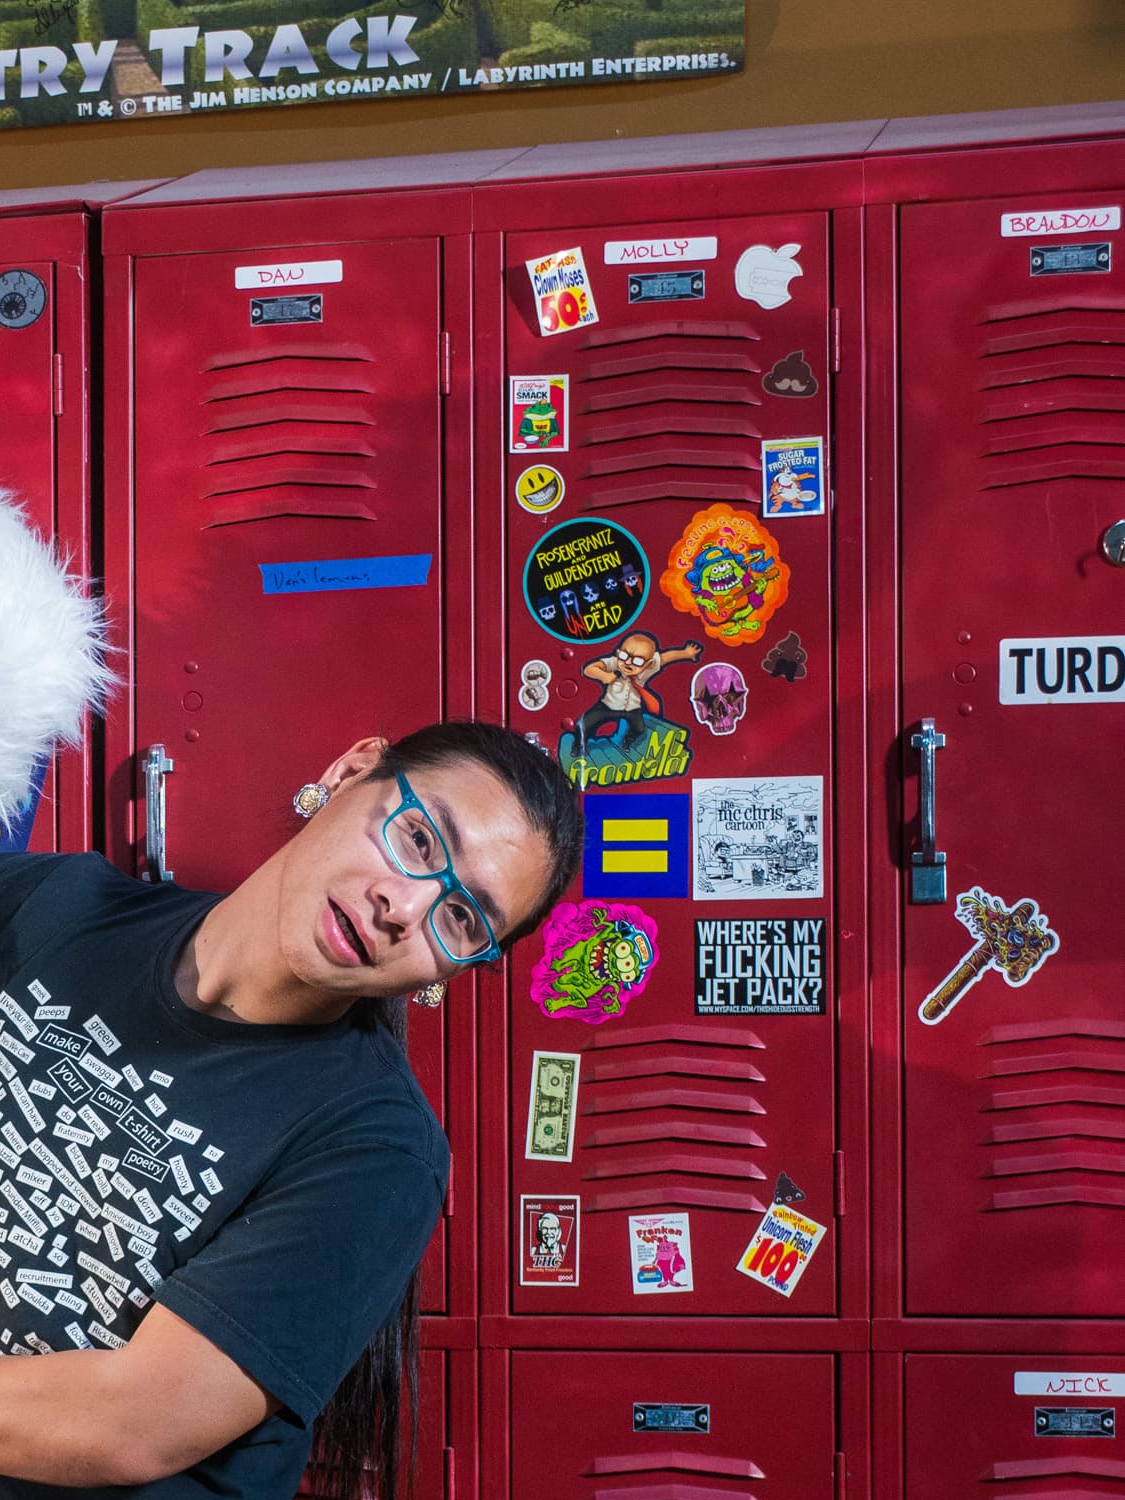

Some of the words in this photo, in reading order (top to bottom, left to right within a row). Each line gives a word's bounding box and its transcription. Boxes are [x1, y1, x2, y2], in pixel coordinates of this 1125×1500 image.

[149, 15, 418, 86] TRACK
[97, 101, 113, 117] &
[142, 95, 182, 112] THE
[189, 91, 227, 108] JIM
[233, 82, 317, 104] HENSON
[324, 73, 432, 96] COMPANY
[458, 61, 584, 85] LABYRINTH
[592, 53, 737, 76] ENTERPRISES.
[1009, 214, 1110, 232] BRANDON
[620, 240, 689, 260] MOLLY
[257, 268, 304, 283] DAN
[534, 274, 559, 296] Clown
[557, 268, 584, 288] Noses
[516, 391, 548, 399] SMACK
[768, 457, 802, 472] FROSTED
[803, 456, 817, 465] FAT
[778, 450, 804, 460] SUGAR
[535, 528, 615, 569] ROSENCRANTZ
[572, 555, 586, 564] AND
[544, 550, 623, 591] GUILDENSTERN
[590, 601, 607, 612] ARE
[718, 809, 742, 822] mc
[744, 803, 784, 821] chris
[720, 800, 734, 810] the
[725, 820, 765, 831] cartoon
[697, 920, 786, 945] WHERE'S
[793, 920, 824, 944] MY
[699, 945, 821, 978] FUCKING
[697, 978, 740, 1005] JET
[747, 978, 824, 1005] PACK?
[39, 1008, 66, 1017] peeps
[44, 1031, 81, 1054] make
[90, 1020, 115, 1048] green
[54, 1065, 84, 1092] your
[84, 1057, 116, 1083] swagga
[98, 1091, 124, 1111] own
[28, 1107, 43, 1127] have
[61, 1110, 72, 1120] do
[5, 1127, 23, 1151] where
[57, 1125, 91, 1144] fraternity
[125, 1115, 162, 1150] t-shirt
[173, 1126, 196, 1141] rush
[33, 1142, 63, 1174] chopped
[127, 1153, 165, 1176] poetry
[21, 1170, 47, 1185] mixer
[4, 1185, 24, 1212] Dunder
[60, 1198, 75, 1211] IDK
[137, 1194, 157, 1221] dorm
[559, 1204, 574, 1212] good
[104, 1207, 136, 1232] American
[136, 1225, 153, 1240] boy
[169, 1201, 196, 1226] sweet
[13, 1232, 39, 1252] atcha
[635, 1226, 683, 1239] Franken
[761, 1215, 792, 1244] Unicorn
[789, 1230, 814, 1256] Flesh
[132, 1241, 152, 1257] NBD
[80, 1258, 99, 1272] more
[532, 1256, 562, 1268] THC
[19, 1271, 68, 1286] recruitment
[21, 1287, 50, 1311] woulda
[60, 1293, 83, 1311] bling
[92, 1325, 107, 1340] Rick
[1046, 1377, 1113, 1393] NICK
